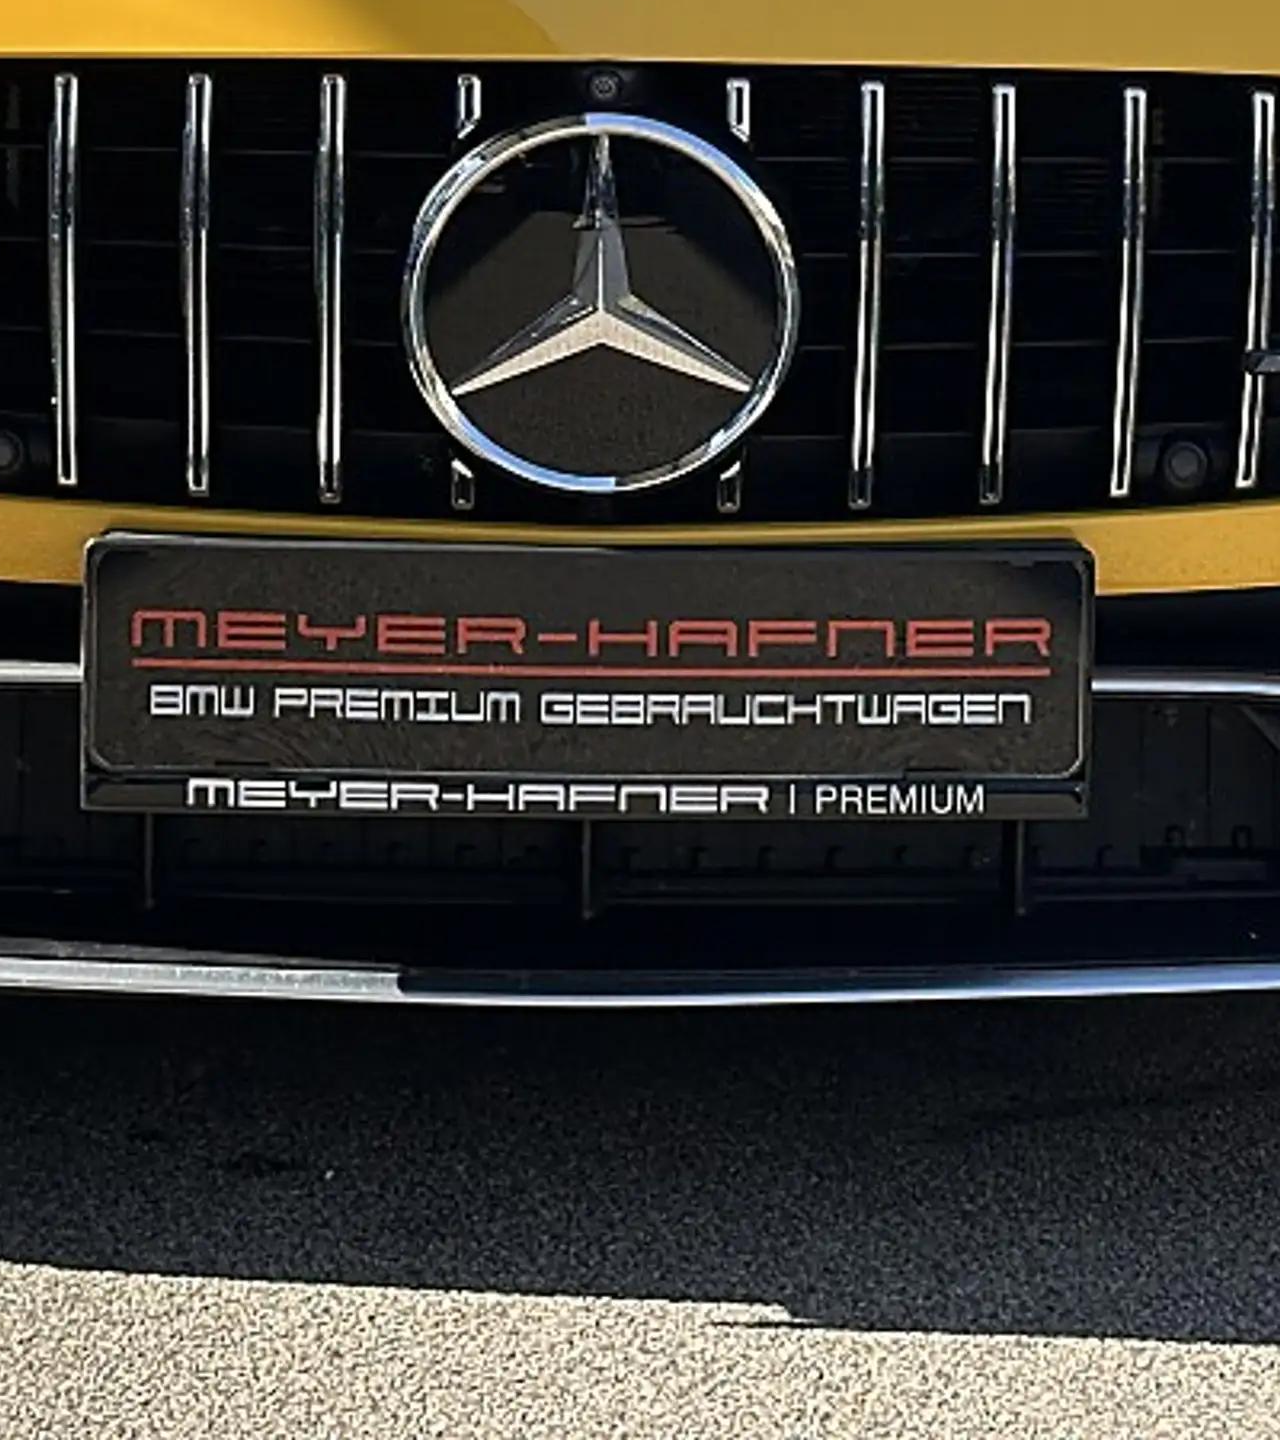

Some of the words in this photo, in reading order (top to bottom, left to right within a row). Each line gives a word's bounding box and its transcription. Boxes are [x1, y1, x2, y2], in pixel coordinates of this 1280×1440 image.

[132, 610, 1051, 657] MEYER-HAFNER
[150, 684, 254, 716] BMW
[274, 686, 520, 724] PREMIUM
[540, 692, 1031, 725] GEBRAUCHTWAGEN
[187, 778, 770, 812] MEYER-HAFNER
[815, 783, 984, 815] PREMIUM
